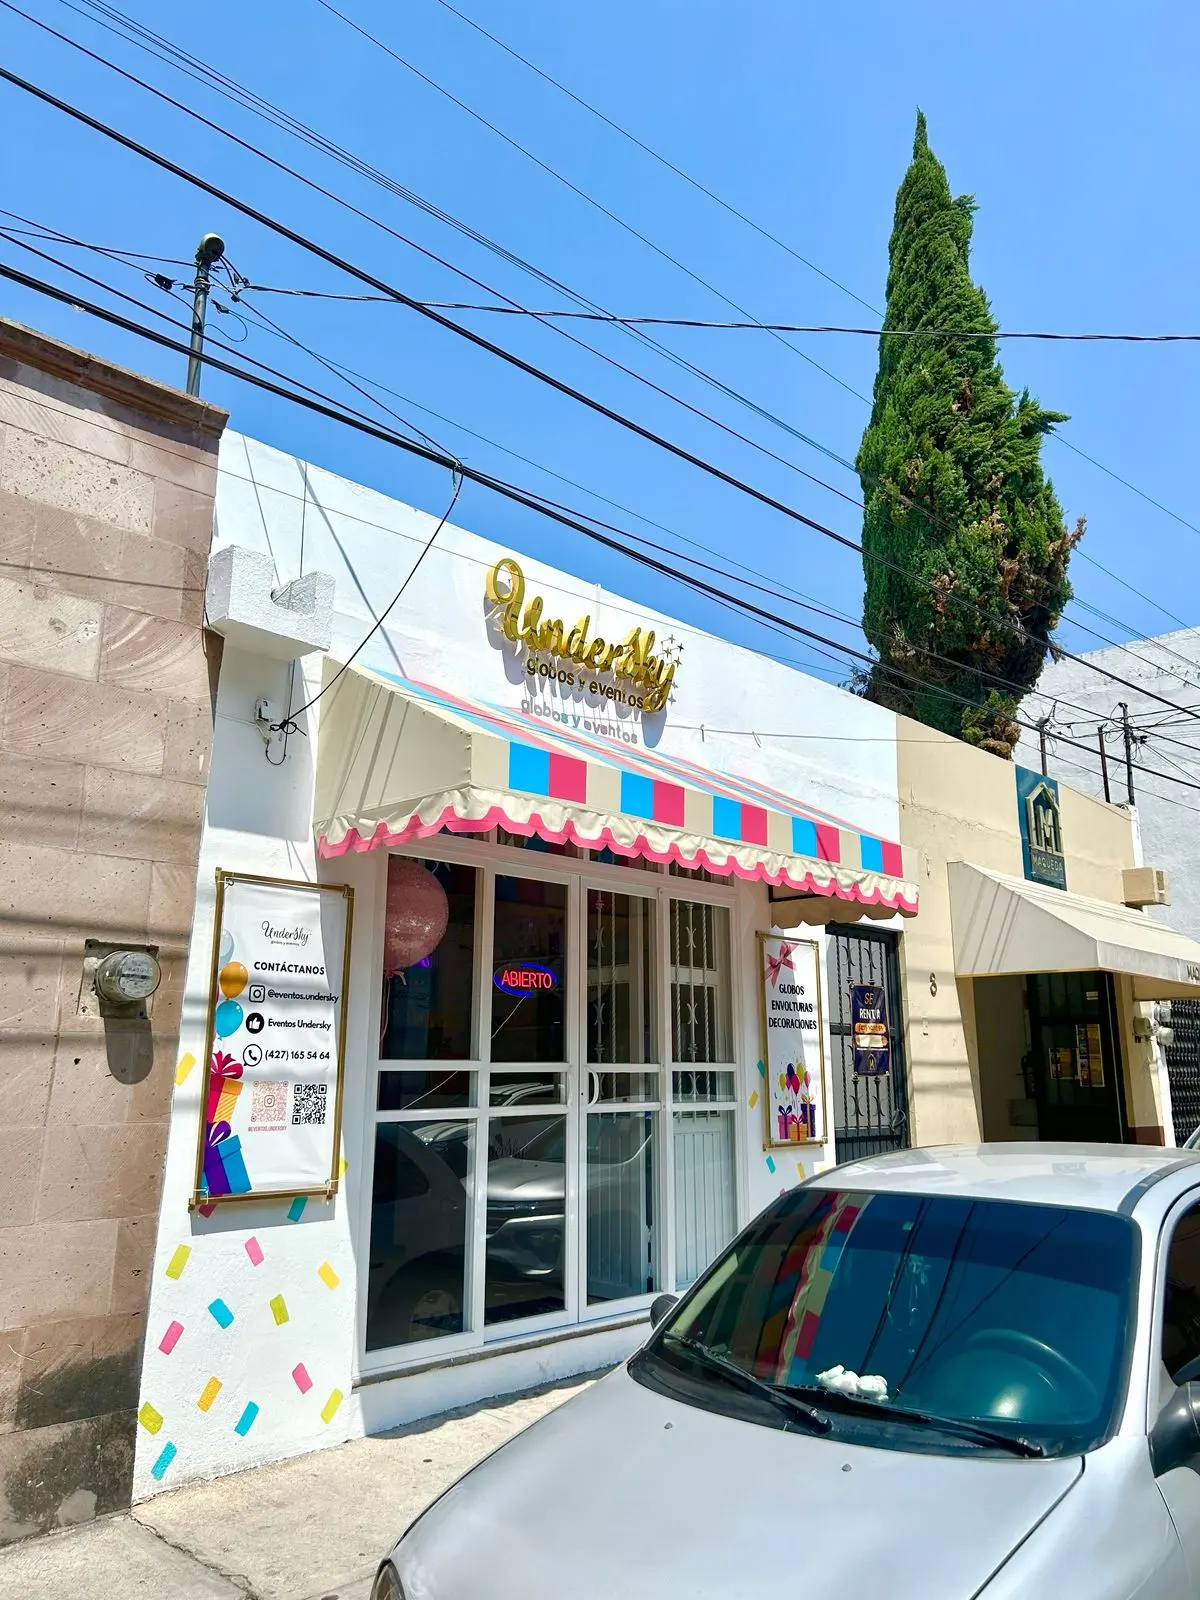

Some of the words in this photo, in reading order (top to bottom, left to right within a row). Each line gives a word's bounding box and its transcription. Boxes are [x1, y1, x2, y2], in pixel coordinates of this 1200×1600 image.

[527, 657, 575, 686] globos
[578, 679, 585, 692] y
[589, 680, 644, 710] eventos
[1032, 855, 1063, 872] MAQUEDA
[254, 961, 325, 975] CONTÁCTANOS
[501, 969, 552, 989] ABIERTO
[929, 972, 938, 997] 8
[267, 988, 339, 1004] @eventos.undersky
[778, 983, 805, 996] GLOBOS
[864, 992, 874, 1005] SE
[771, 999, 813, 1013] ENVOLTURAS
[859, 1008, 881, 1020] RENTA
[267, 1018, 296, 1028] Eventos
[297, 1019, 332, 1031] Undersky
[768, 1017, 817, 1029] DECORACIONES
[265, 1049, 289, 1061] (427)
[291, 1051, 305, 1059] 165
[306, 1051, 318, 1060] 54
[319, 1051, 330, 1060] 64
